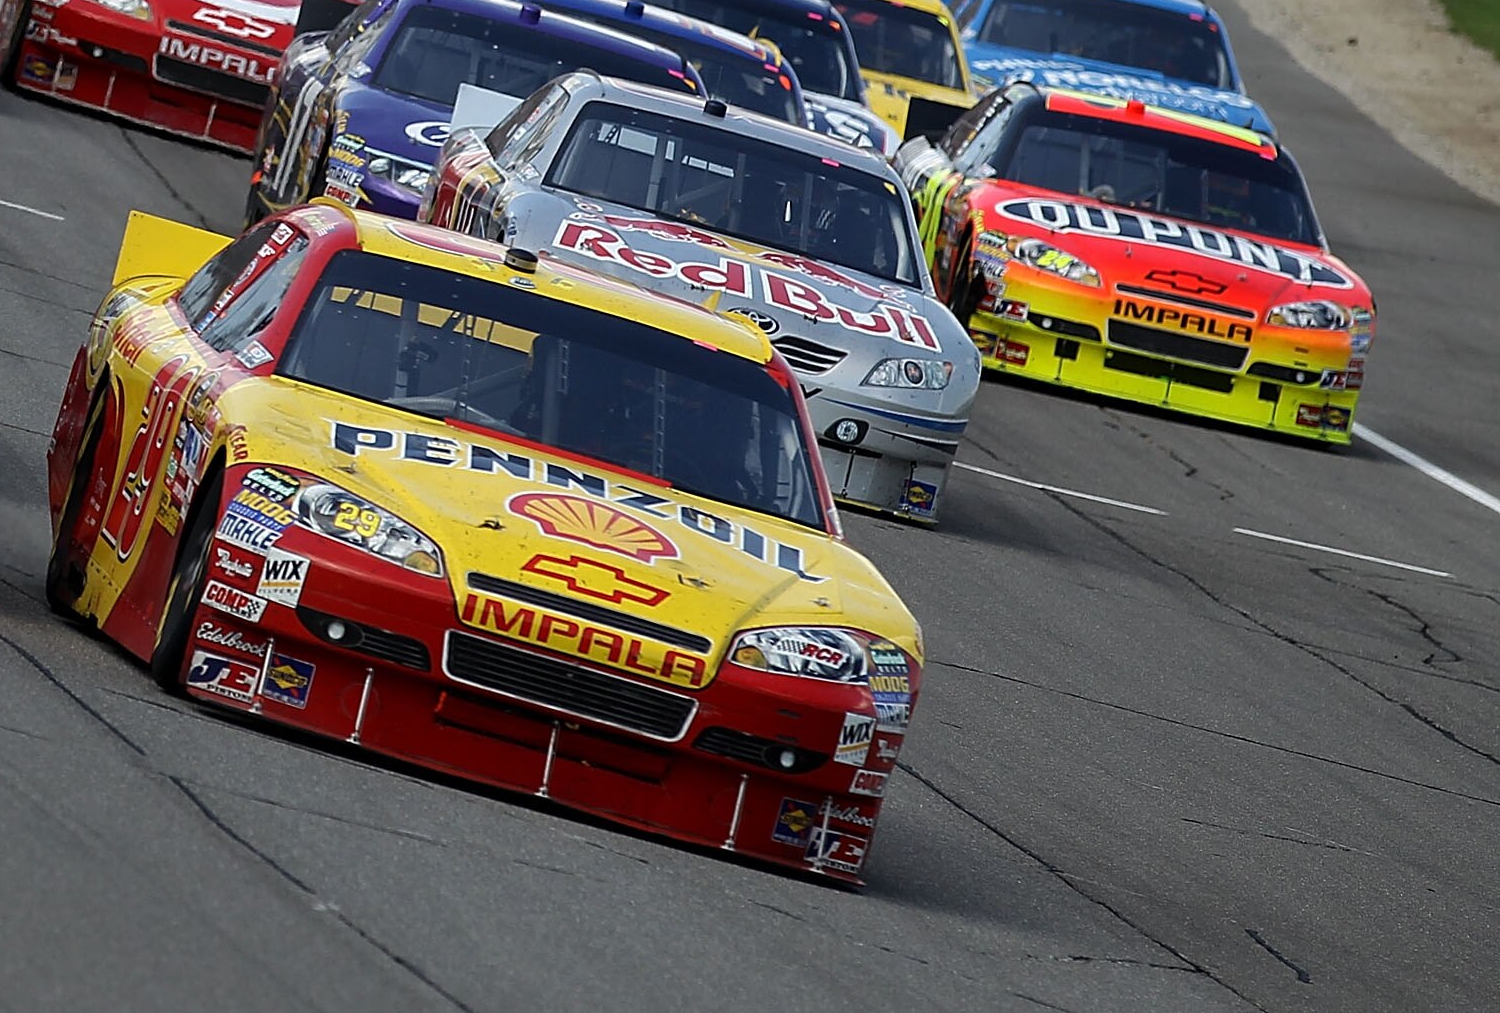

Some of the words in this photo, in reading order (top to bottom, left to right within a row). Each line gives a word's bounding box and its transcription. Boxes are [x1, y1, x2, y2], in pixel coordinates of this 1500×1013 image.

[552, 218, 752, 299] Red
[759, 268, 942, 354] Bull
[1114, 299, 1254, 344] IMPALA
[232, 489, 296, 526] MOOG
[242, 479, 284, 501] BELTS
[329, 419, 833, 585] PENNZOIL
[219, 513, 283, 551] MAHLE
[333, 500, 382, 538] 29
[265, 560, 303, 581] WIX
[205, 585, 250, 611] COMP
[197, 622, 266, 658] Edelbrock
[462, 593, 707, 688] IMPALA
[800, 643, 844, 666] RCR
[188, 657, 259, 691] JE
[870, 676, 909, 693] MOOG
[842, 721, 874, 746] WIX
